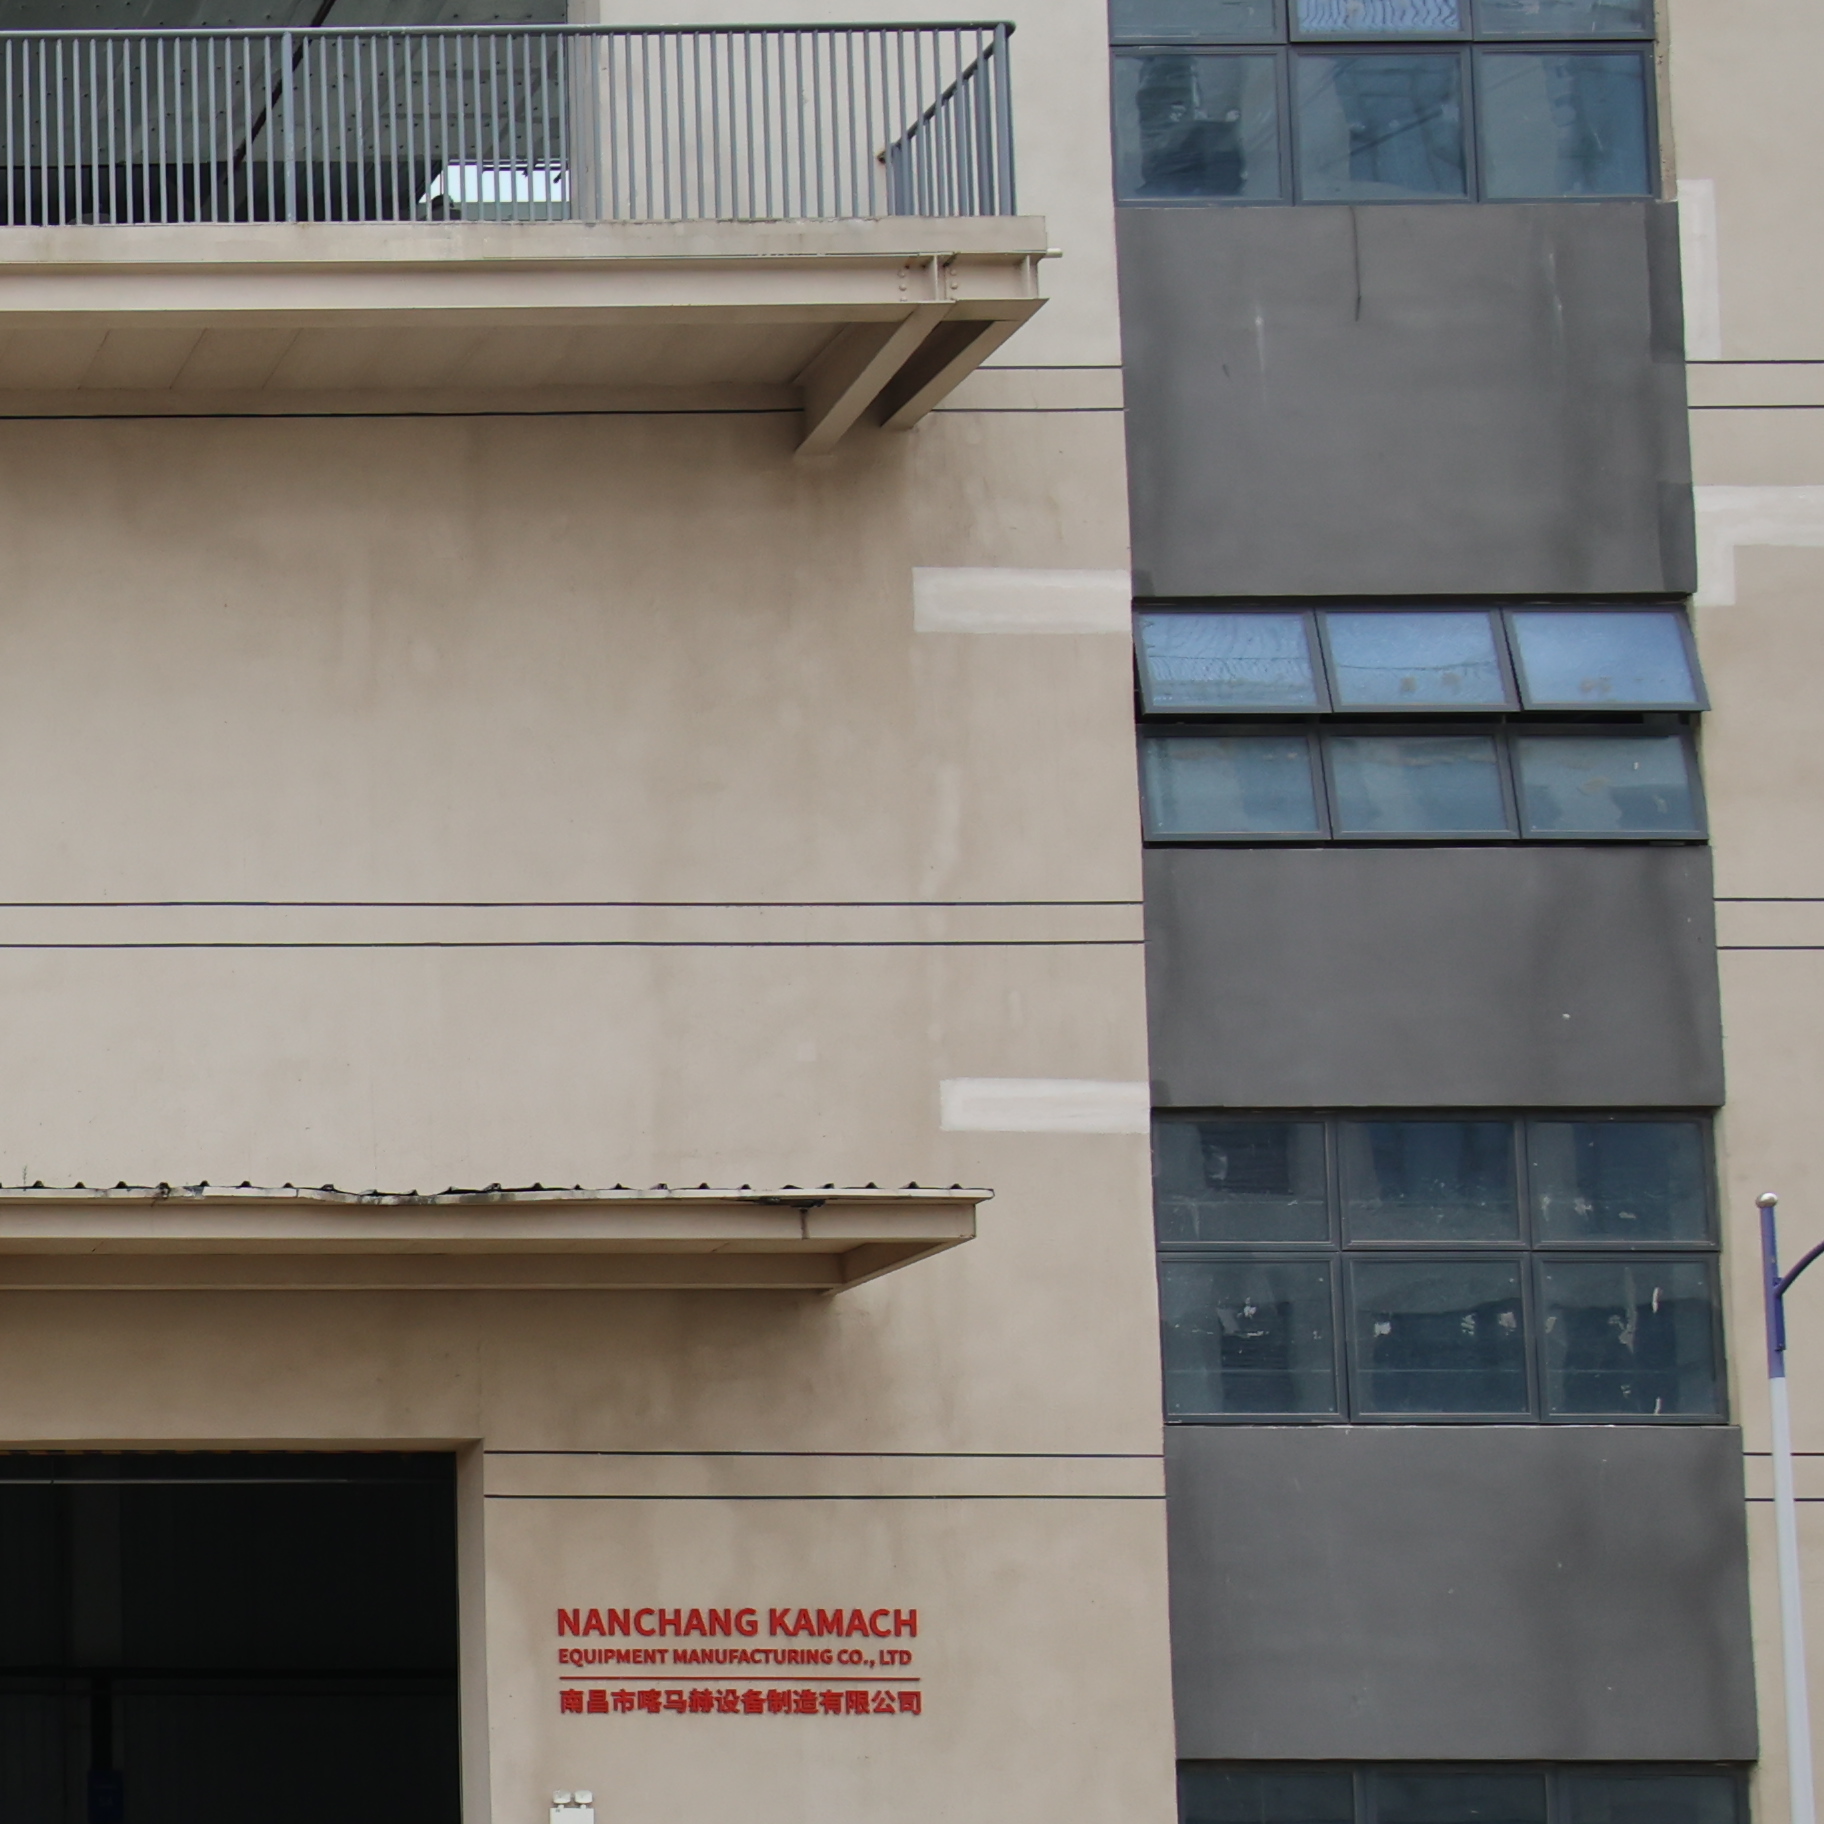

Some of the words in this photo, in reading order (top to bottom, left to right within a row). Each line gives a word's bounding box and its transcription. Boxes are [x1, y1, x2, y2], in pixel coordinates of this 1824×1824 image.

[557, 1608, 758, 1637] NANCHANG
[769, 1608, 918, 1637] KAMACH
[558, 1648, 669, 1667] EQUIPMENT
[673, 1648, 833, 1665] MANUFACTURING
[879, 1649, 912, 1666] LTD
[559, 1688, 922, 1715] 南昌市喀马赫设备制造有限公司
